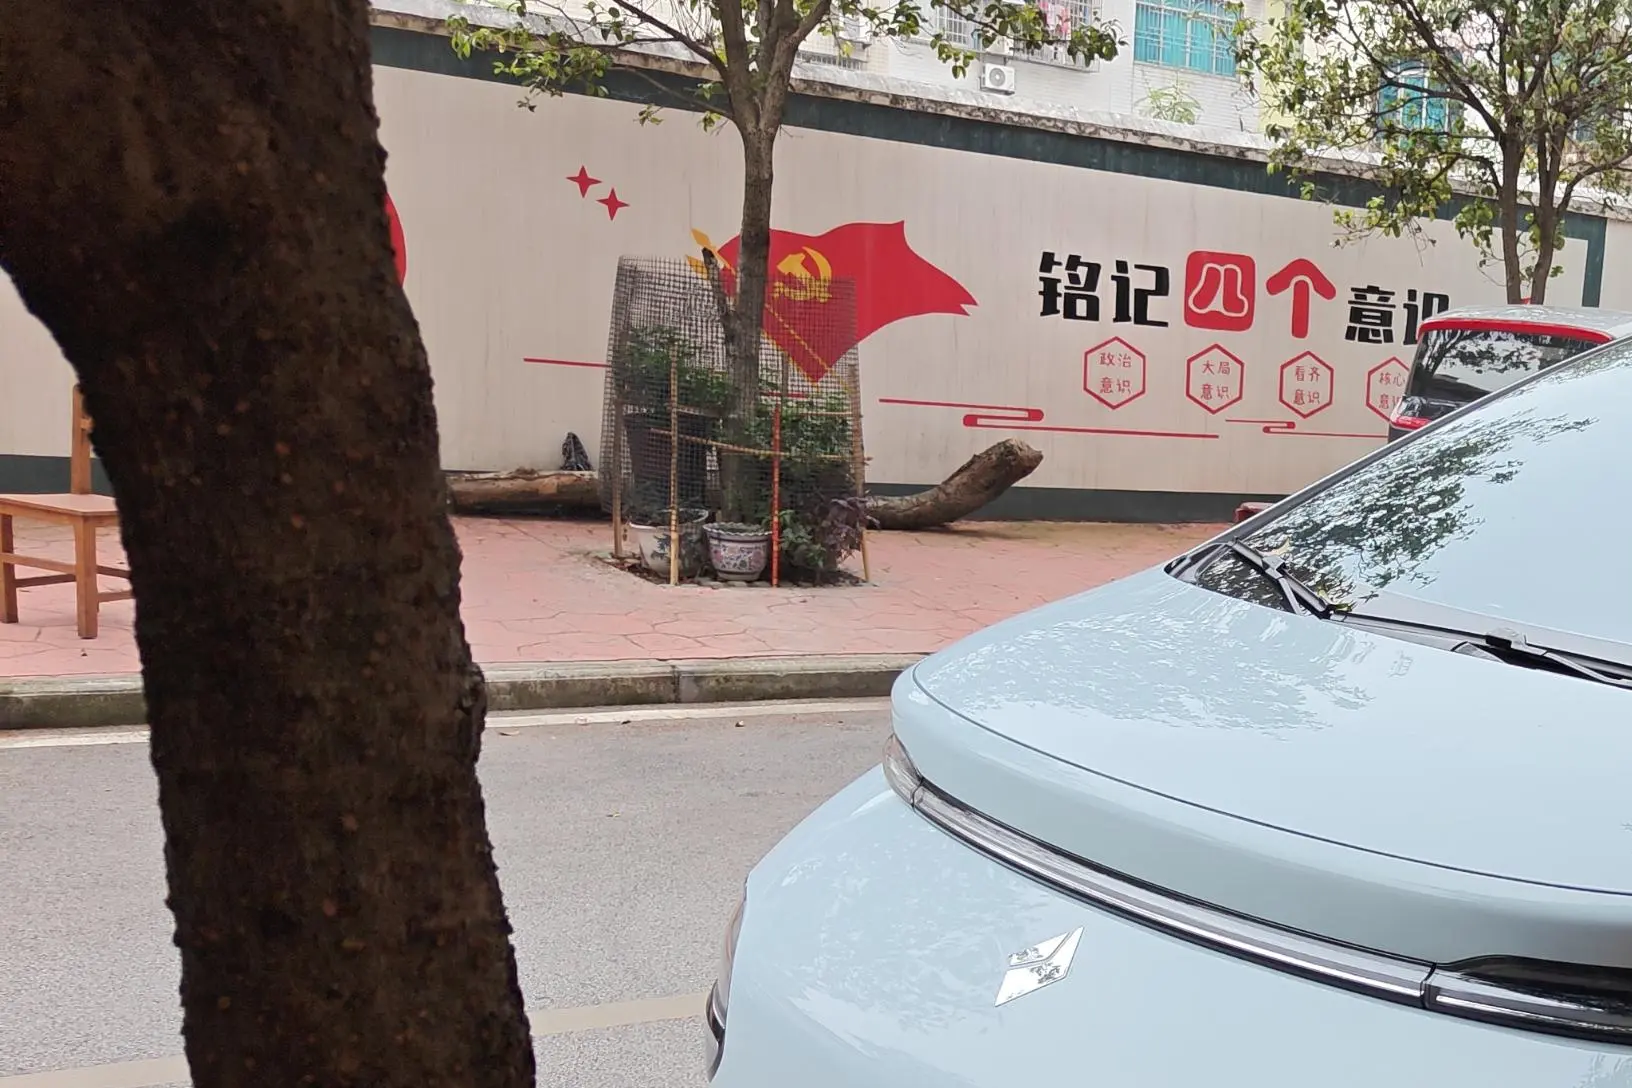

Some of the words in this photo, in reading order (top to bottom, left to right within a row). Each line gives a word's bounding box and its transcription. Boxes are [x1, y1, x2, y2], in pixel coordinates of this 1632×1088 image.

[1100, 352, 1132, 368] 政治
[1202, 360, 1230, 375] 大局
[1294, 366, 1320, 382] 看齐
[1379, 372, 1405, 387] 核心
[1100, 377, 1132, 394] 意识
[1201, 383, 1230, 399] 意识
[1293, 389, 1320, 405] 意识
